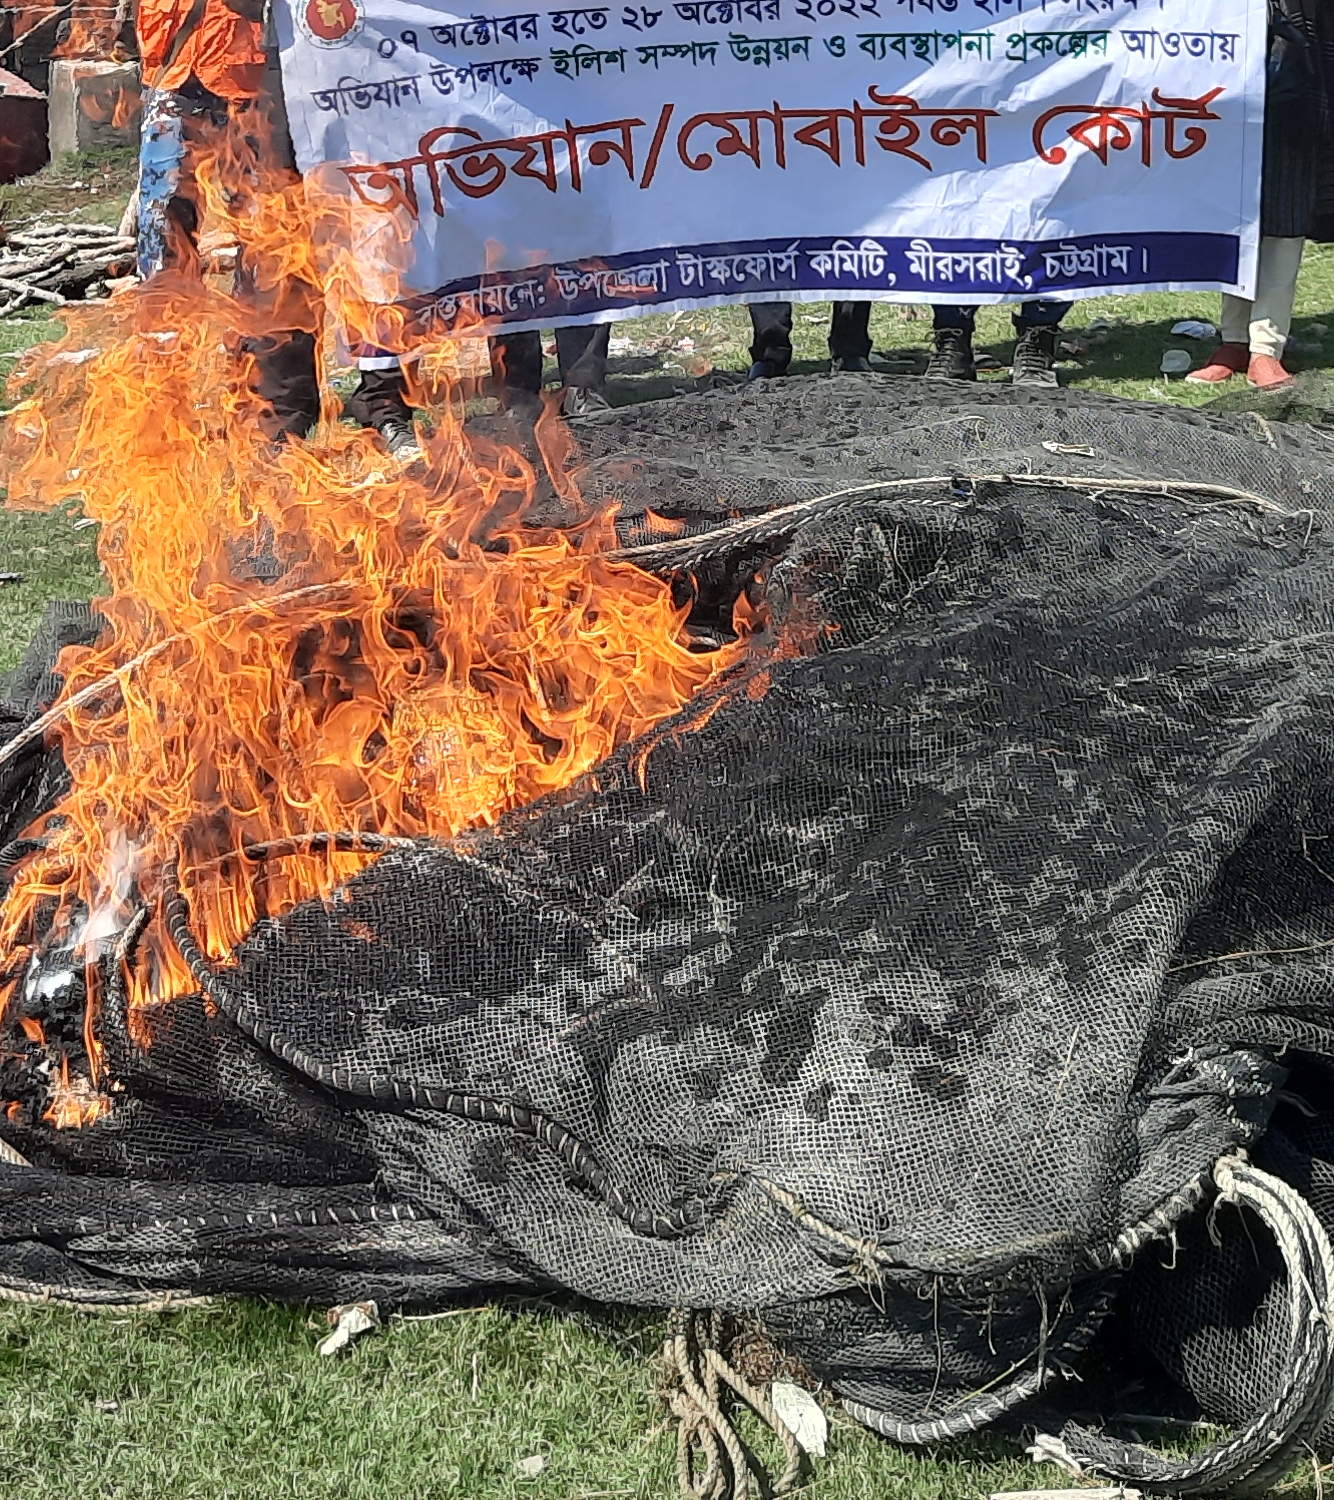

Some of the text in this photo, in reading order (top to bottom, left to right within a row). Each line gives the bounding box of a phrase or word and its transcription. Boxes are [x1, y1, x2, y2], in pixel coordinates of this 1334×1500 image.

[376, 29, 420, 59] ০৭
[427, 13, 540, 48] অক্টোবর
[547, 7, 611, 40] হতে
[621, 5, 663, 32] ২৮
[310, 27, 1241, 118] অভিযান উপলক্ষে ইলিশ সম্পদ উন্নয়ন ও ব্যবস্থাপনা প্রকল্পের আওতায়
[1032, 86, 1228, 168] কোর্ট
[554, 258, 670, 301] উপজেলা
[675, 240, 801, 288] টাস্কফোর্স
[805, 239, 897, 287] কমিটি,
[904, 239, 1033, 291] মীরসরাই,
